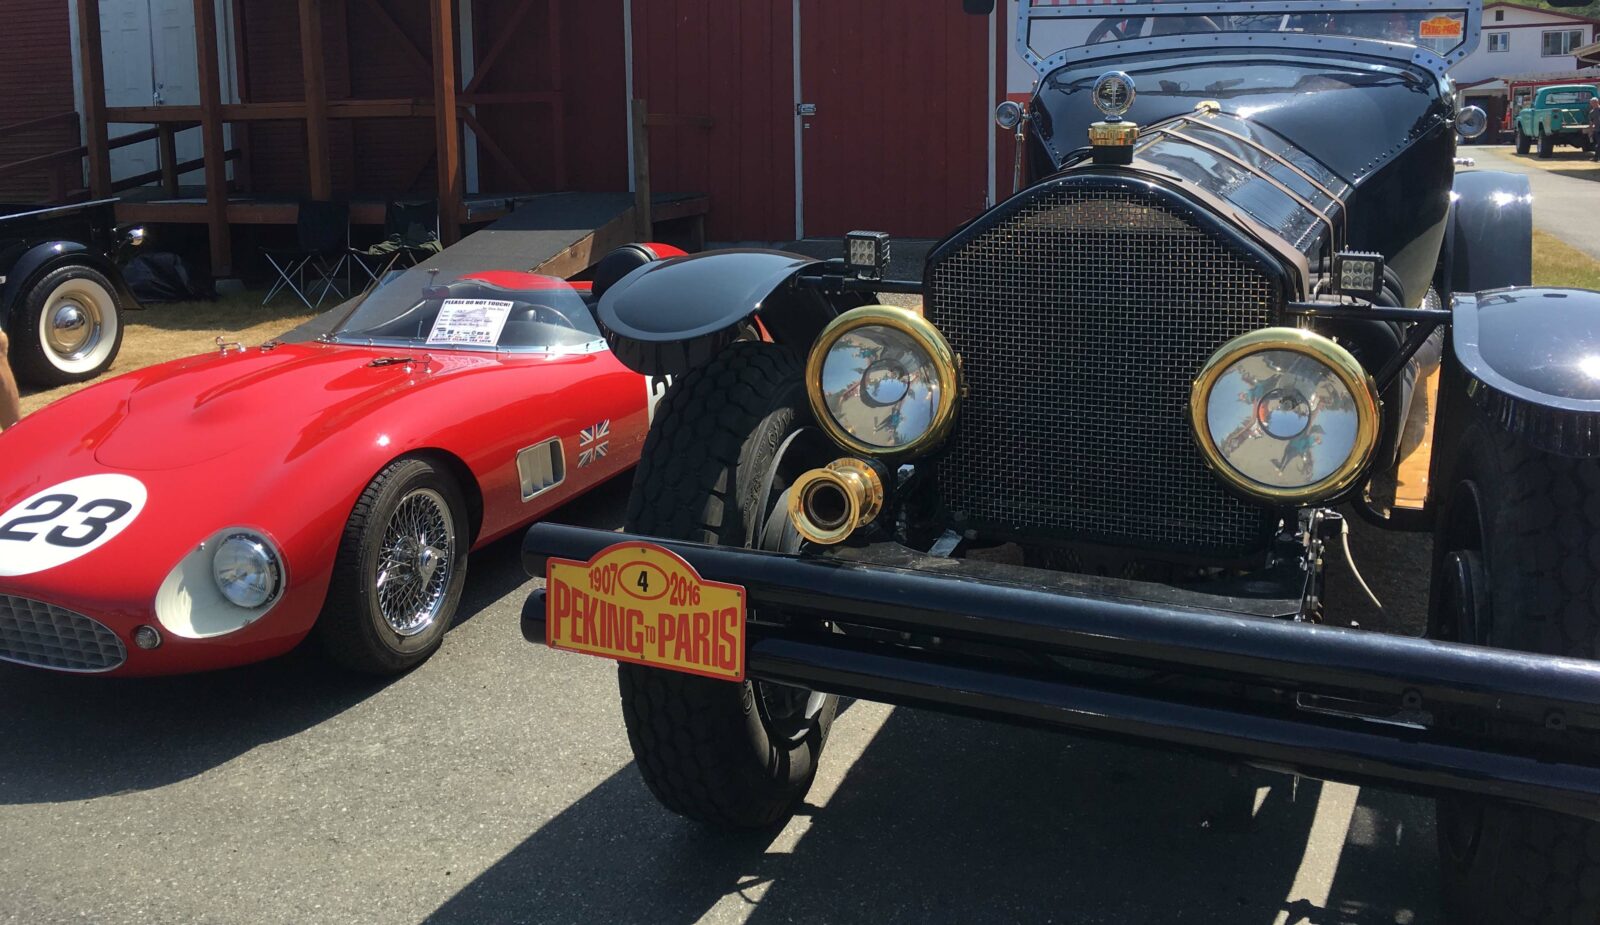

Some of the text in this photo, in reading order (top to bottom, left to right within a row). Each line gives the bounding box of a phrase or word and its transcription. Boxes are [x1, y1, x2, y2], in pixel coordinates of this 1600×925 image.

[0, 493, 132, 548] 23
[588, 562, 701, 607] 1907 4 2016
[553, 577, 738, 671] PEKING TO PARIS
